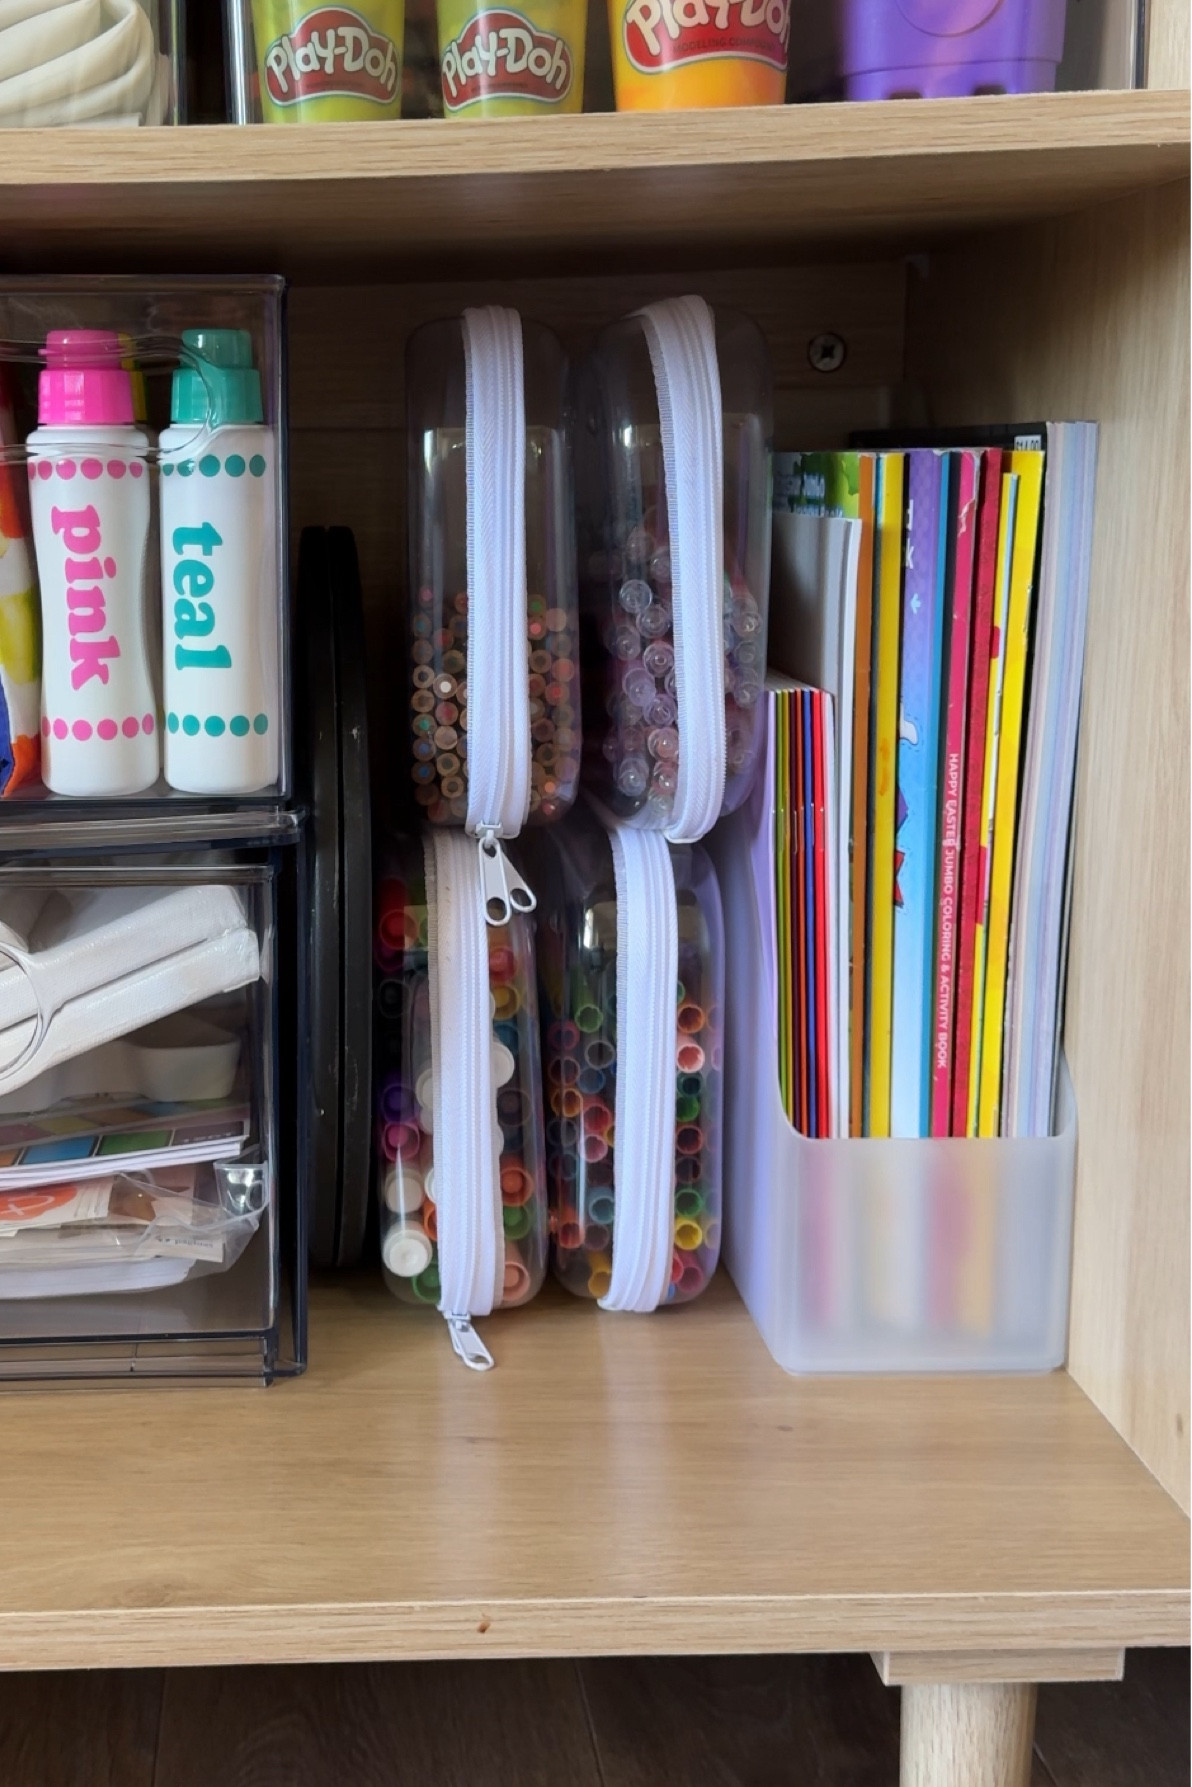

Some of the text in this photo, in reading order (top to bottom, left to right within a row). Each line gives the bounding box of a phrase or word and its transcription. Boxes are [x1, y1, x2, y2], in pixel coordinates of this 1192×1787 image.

[266, 26, 396, 93] Play-Doh
[442, 27, 567, 97] Play-Doh
[51, 504, 121, 691] pink
[172, 521, 232, 671] teal
[948, 753, 960, 797] HAPPY
[943, 849, 955, 895] JUMBO
[941, 896, 953, 962] COLORING
[940, 964, 951, 973] &
[938, 975, 950, 1030] ACTIVITY
[937, 1032, 948, 1069] BOOK
